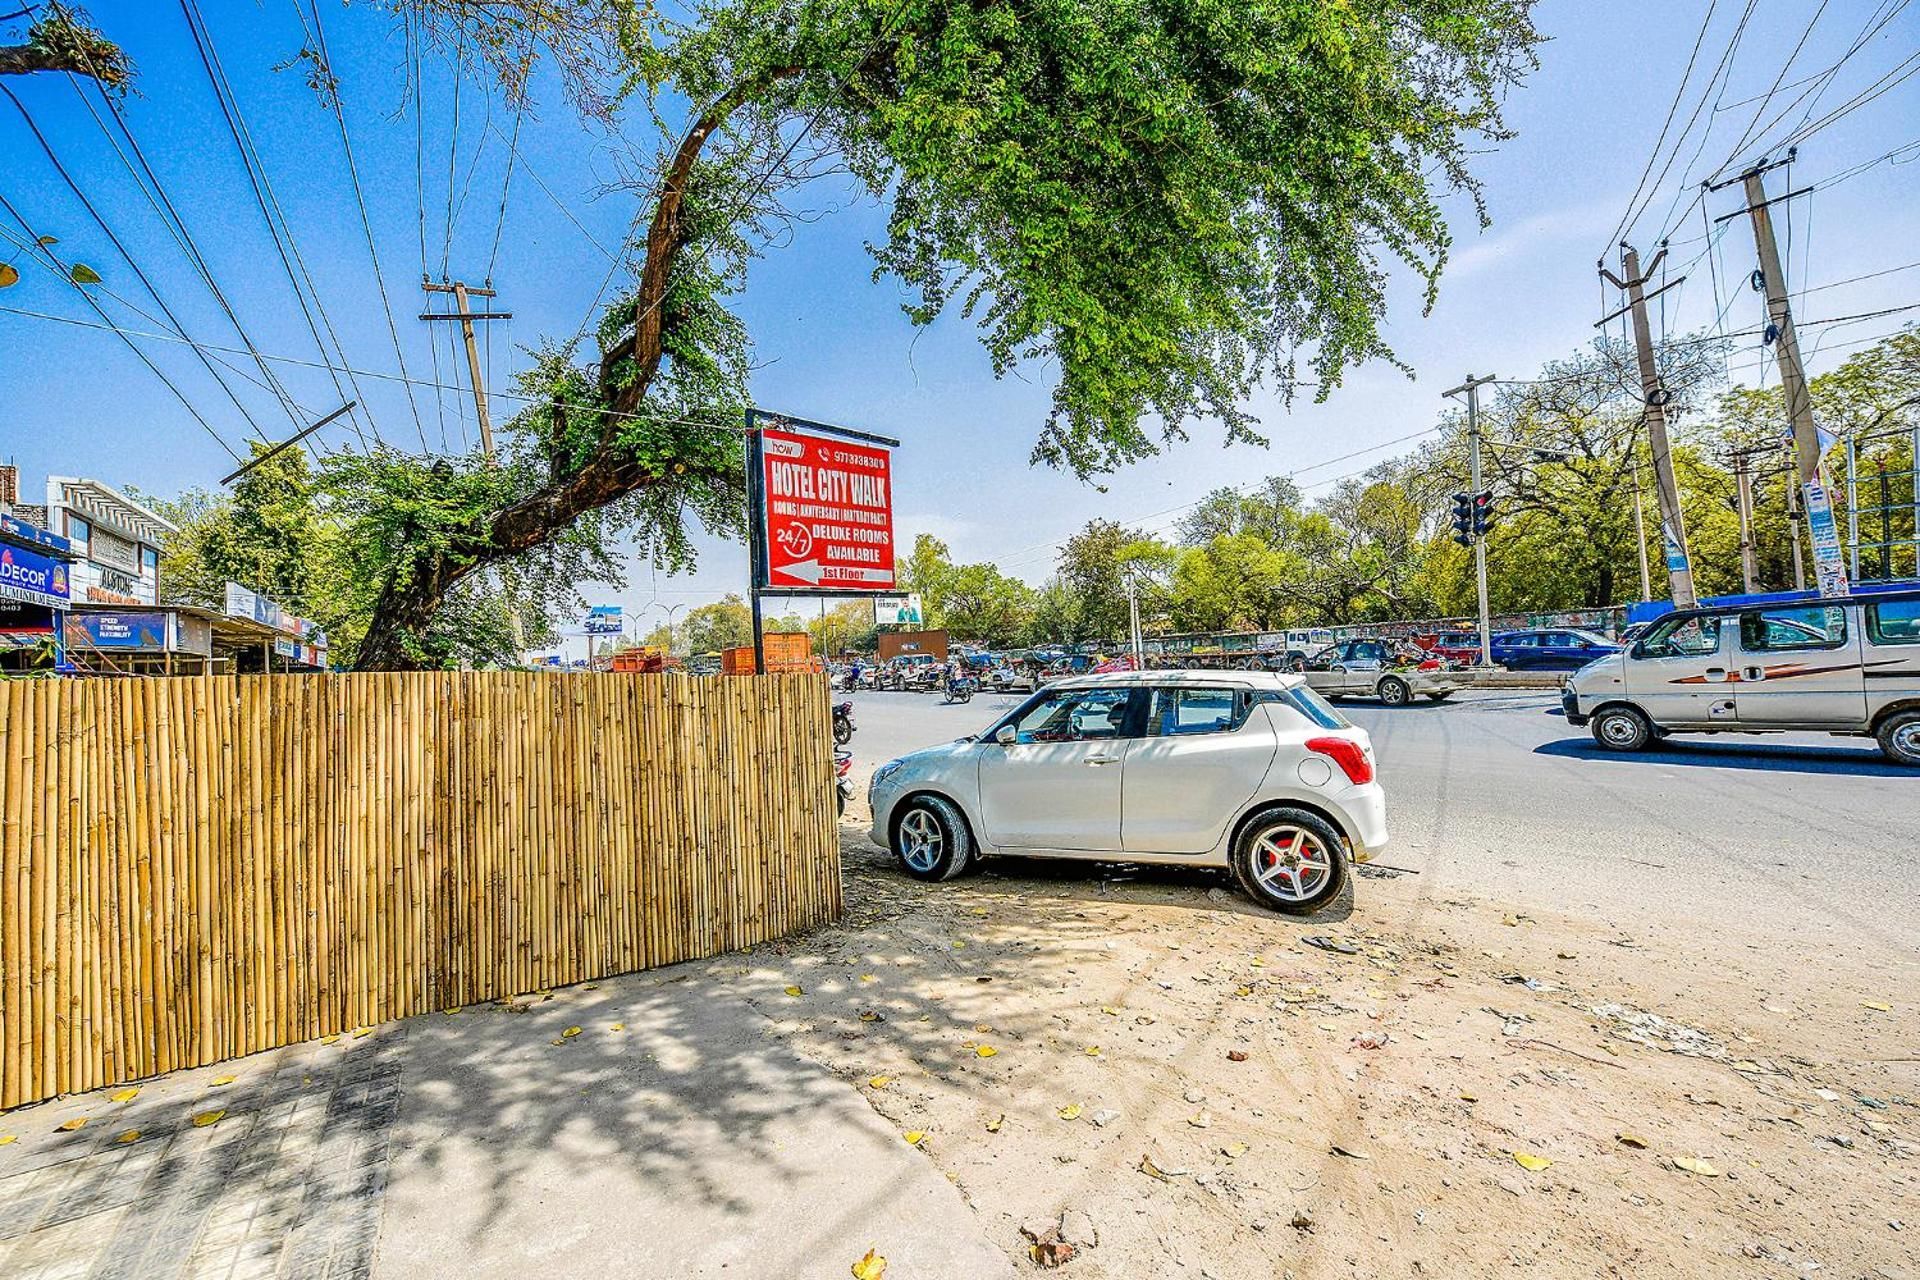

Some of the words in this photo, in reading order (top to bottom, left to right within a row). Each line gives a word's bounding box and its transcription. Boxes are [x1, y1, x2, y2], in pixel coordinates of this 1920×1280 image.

[771, 461, 816, 500] HOTEL
[817, 468, 848, 503] CITY
[850, 473, 887, 508] WALK
[777, 528, 807, 552] 24/7
[812, 524, 851, 541] DELUXE
[853, 529, 889, 545] ROOMS
[826, 545, 880, 563] AVAILABLE
[1, 562, 46, 586] DECOR
[822, 567, 838, 579] 1st
[839, 568, 865, 580] Floor
